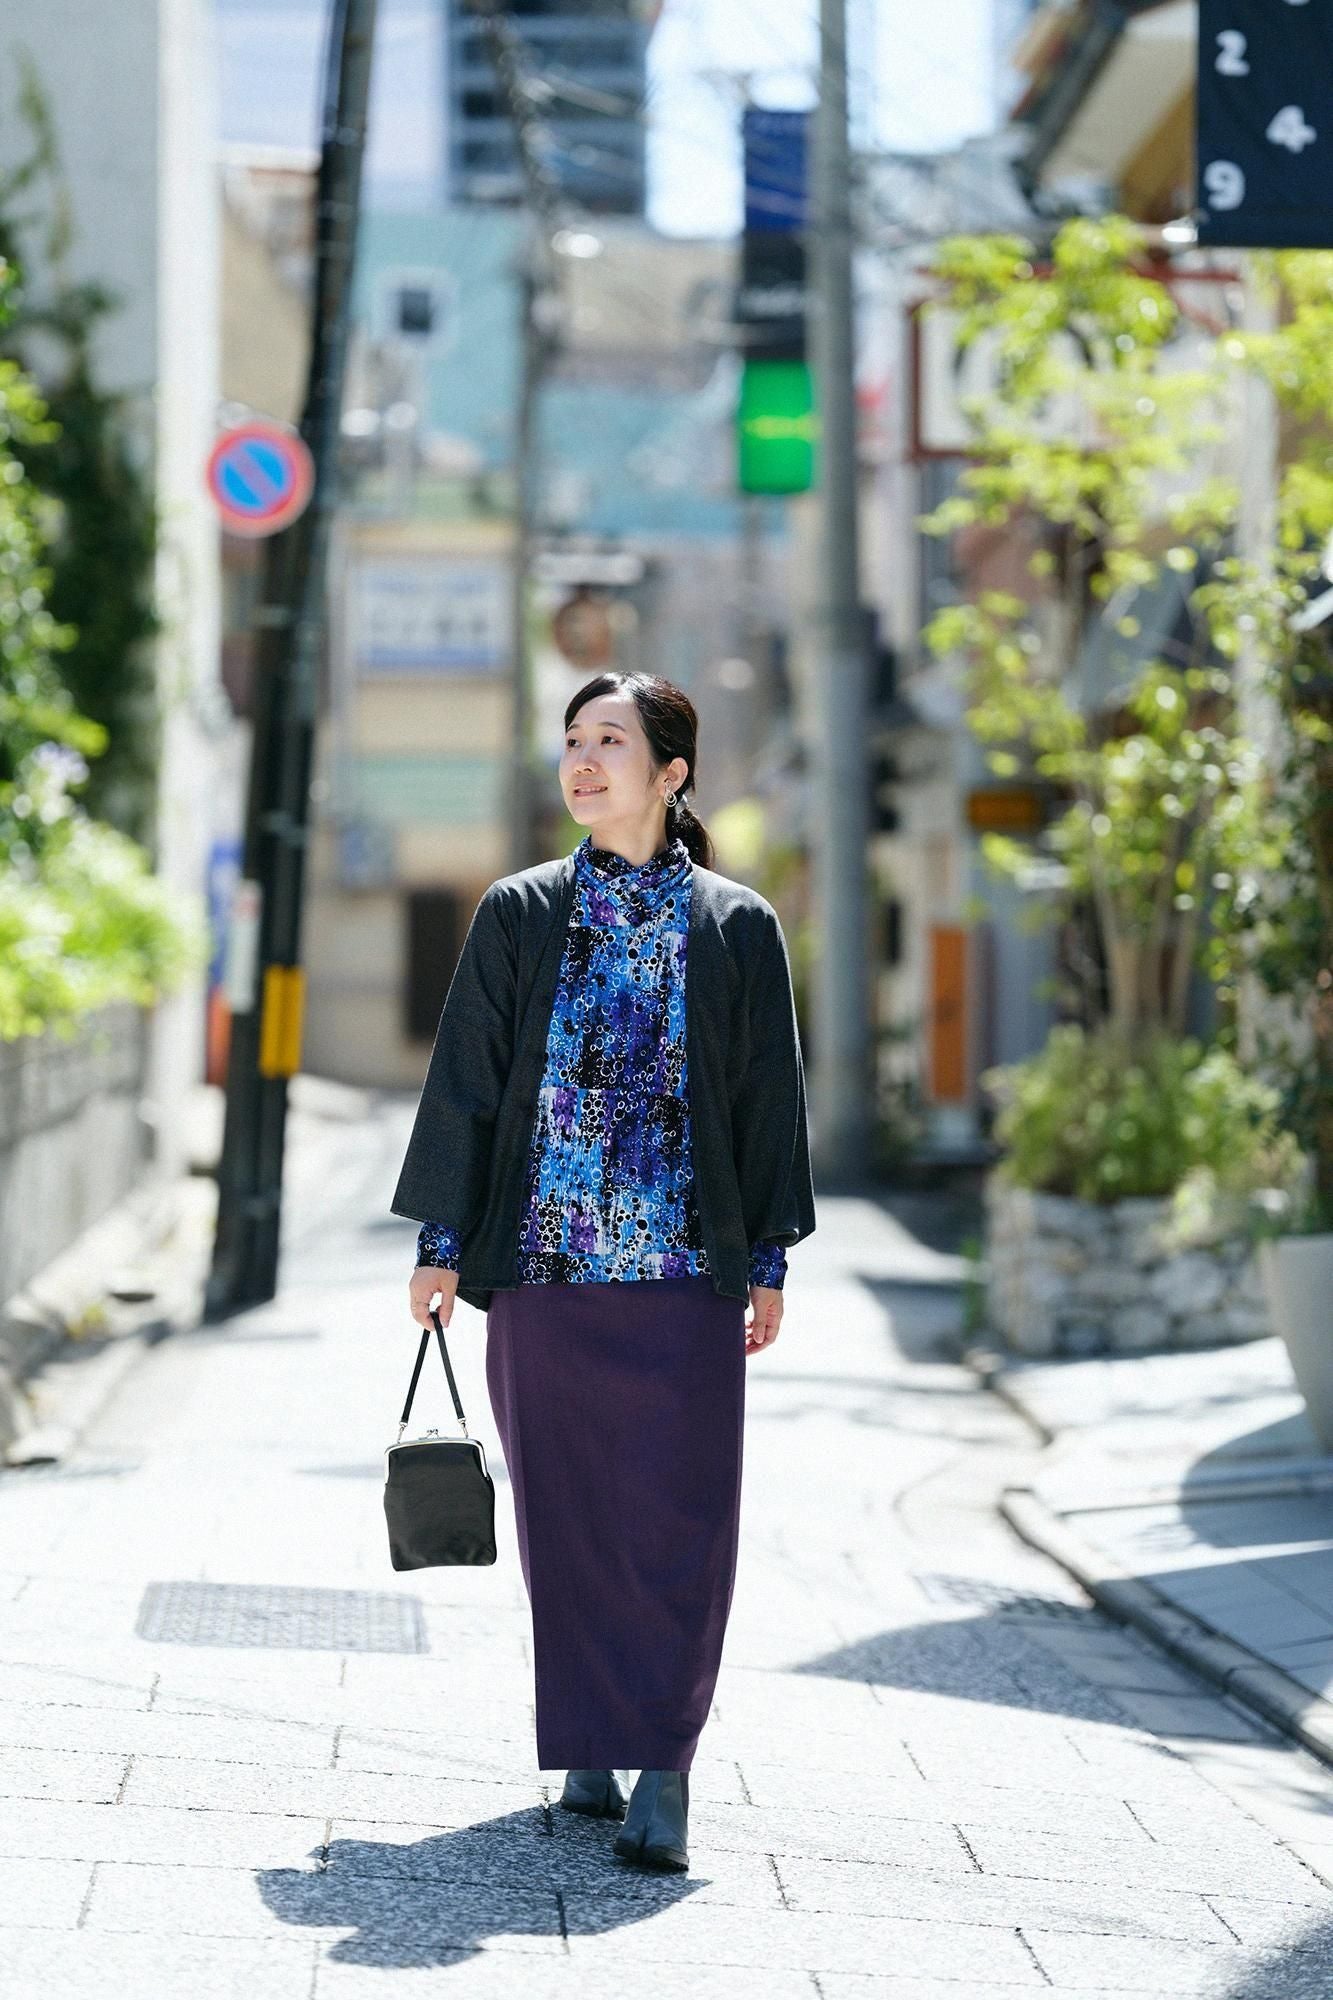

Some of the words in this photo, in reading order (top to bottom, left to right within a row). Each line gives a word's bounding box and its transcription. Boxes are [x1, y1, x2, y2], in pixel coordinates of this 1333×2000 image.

[1214, 29, 1250, 77] 2
[1265, 104, 1317, 153] 4
[1203, 159, 1246, 211] 9
